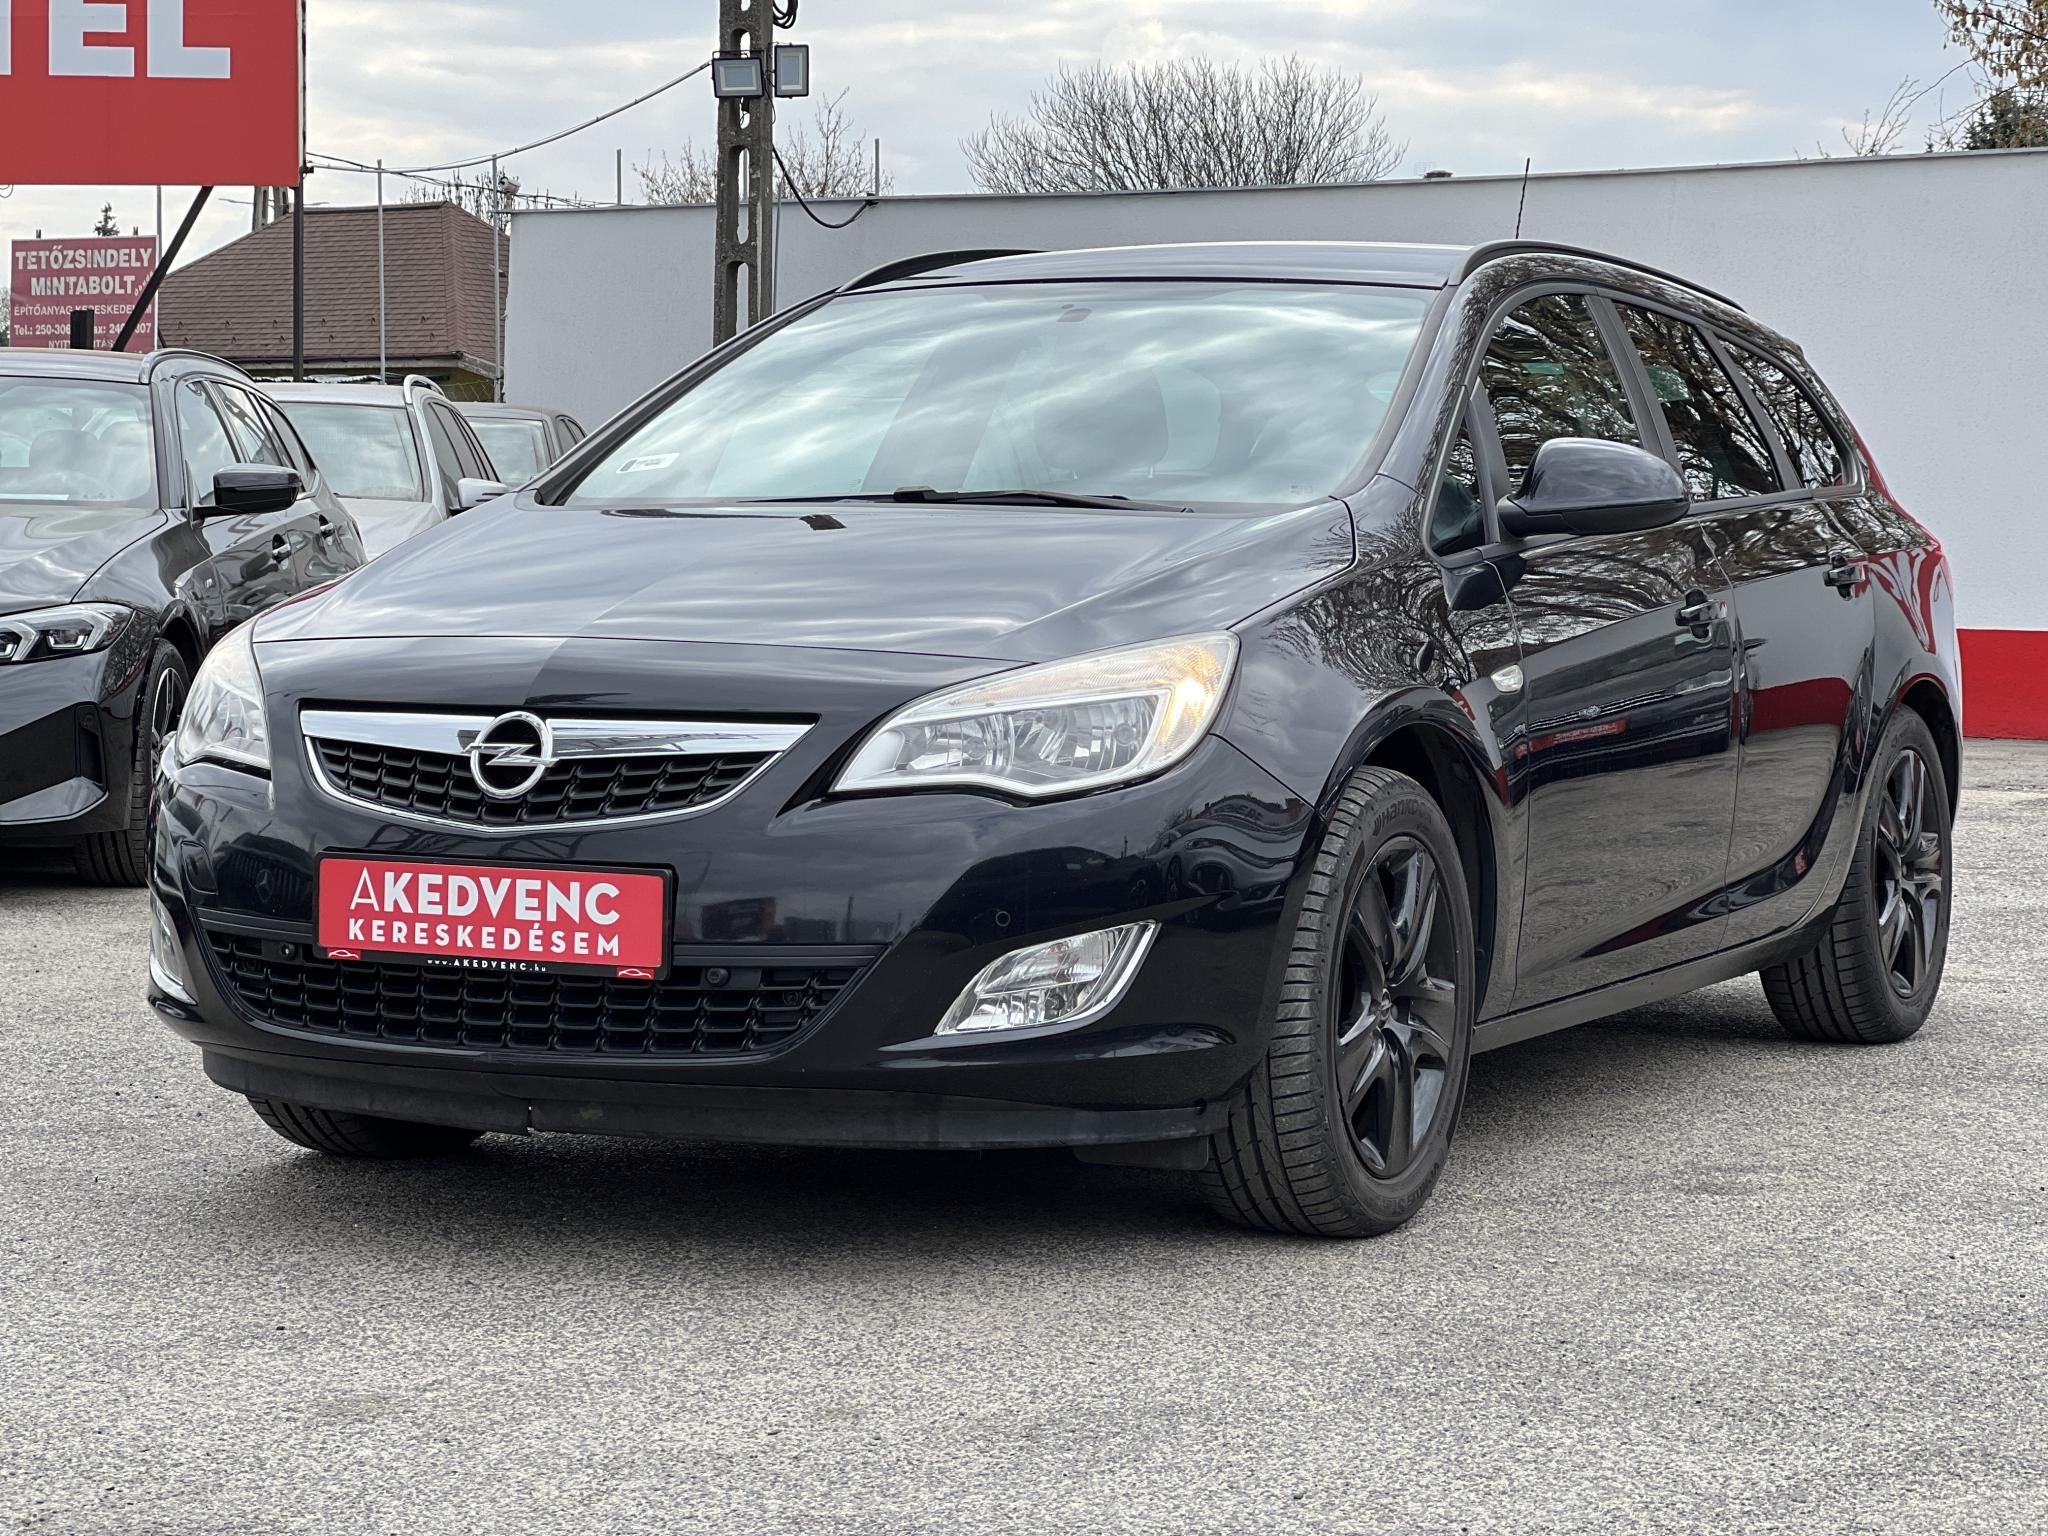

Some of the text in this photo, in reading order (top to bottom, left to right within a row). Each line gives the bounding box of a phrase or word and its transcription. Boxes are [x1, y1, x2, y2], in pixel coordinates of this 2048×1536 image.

[0, 0, 231, 79] EL
[15, 245, 152, 271] TETŐZSINDELY
[31, 275, 136, 296] MINTABOLT
[348, 918, 620, 957] KERESKEDÉSEM
[427, 959, 547, 972] www.AKEDVENC.hu
